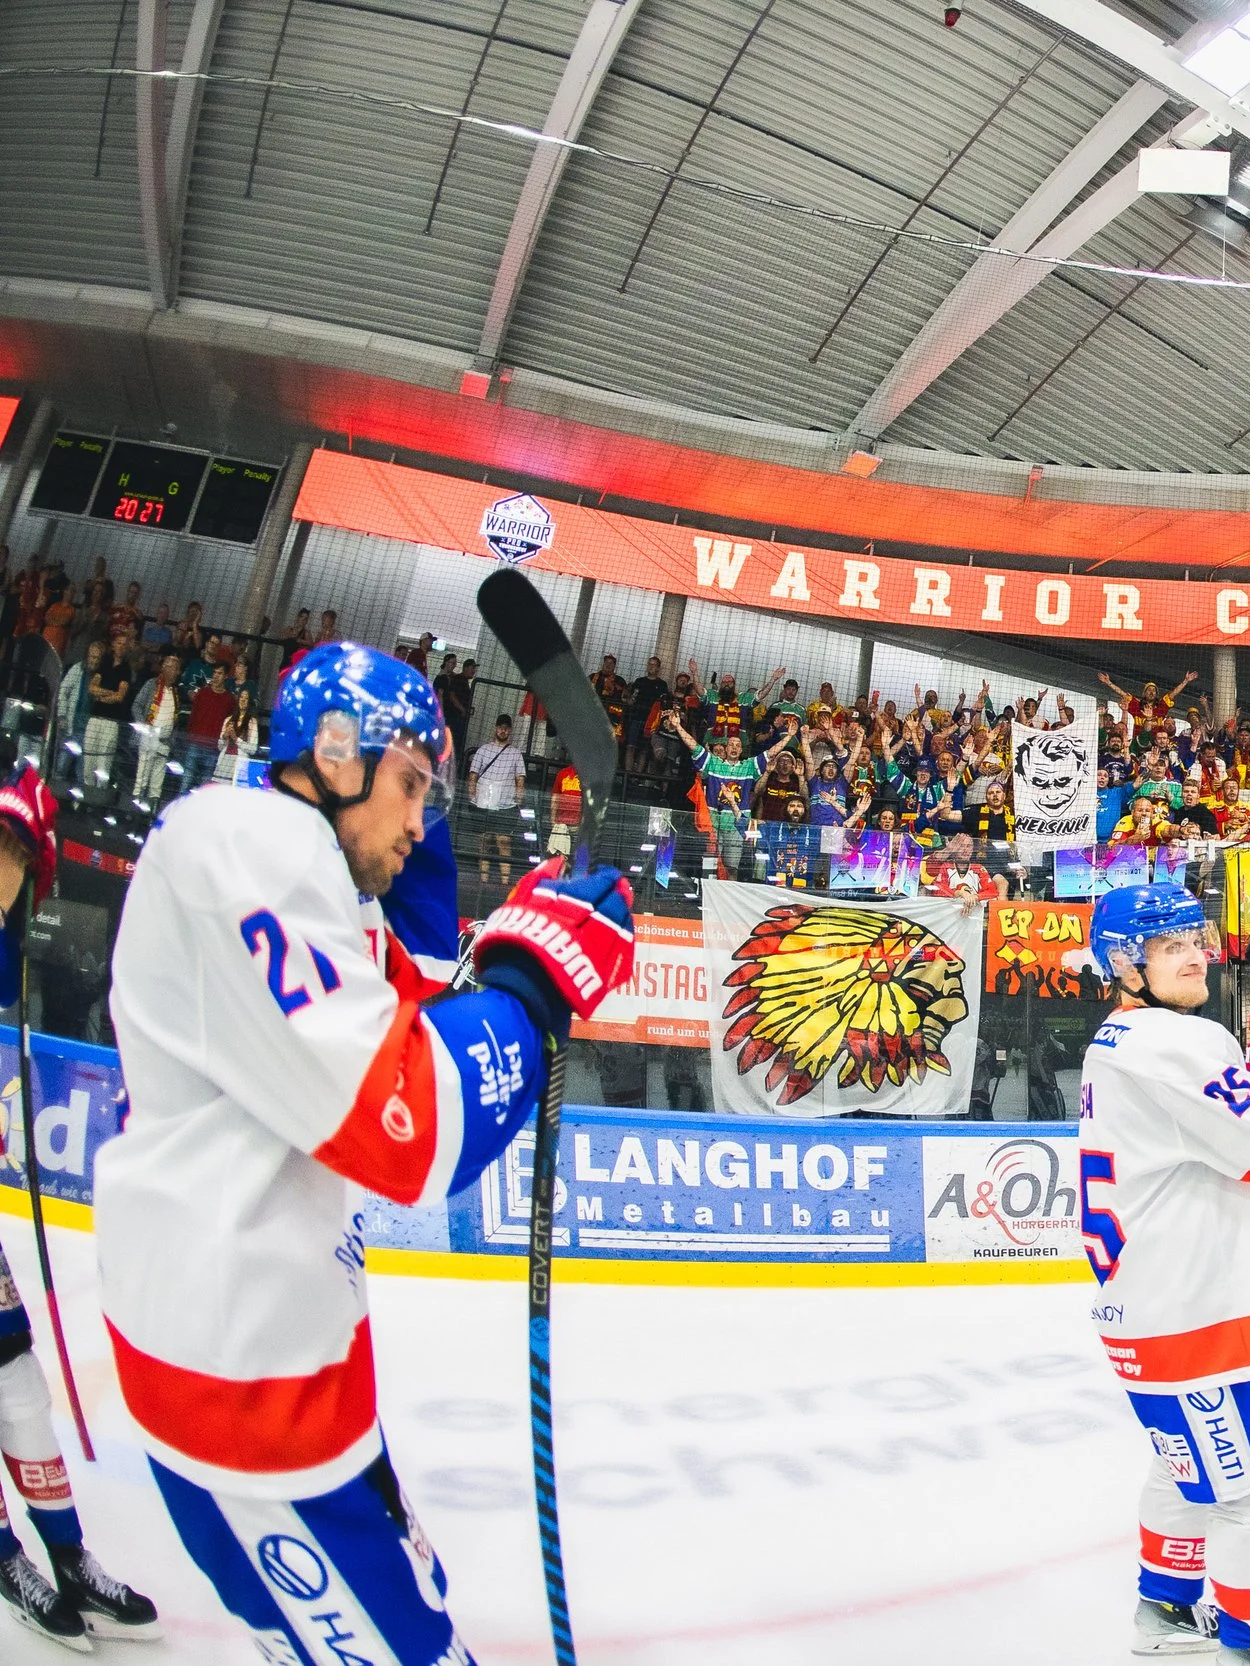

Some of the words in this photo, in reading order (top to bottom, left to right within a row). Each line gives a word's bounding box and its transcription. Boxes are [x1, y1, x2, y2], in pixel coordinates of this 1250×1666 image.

[117, 472, 131, 487] H
[243, 468, 272, 483] Penalty
[168, 482, 179, 496] G
[485, 513, 551, 544] WARRIOR
[693, 535, 1143, 631] WARRIOR
[647, 1025, 674, 1037] rund
[676, 1028, 695, 1038] um
[574, 1132, 888, 1193] LANGHOF
[577, 1195, 890, 1229] Metallbau
[1012, 1218, 1081, 1230] HÖRGERÄT
[532, 1199, 550, 1305] COVERT
[973, 1247, 1059, 1258] KAUFBEUREN
[1205, 1416, 1246, 1481] HALTI
